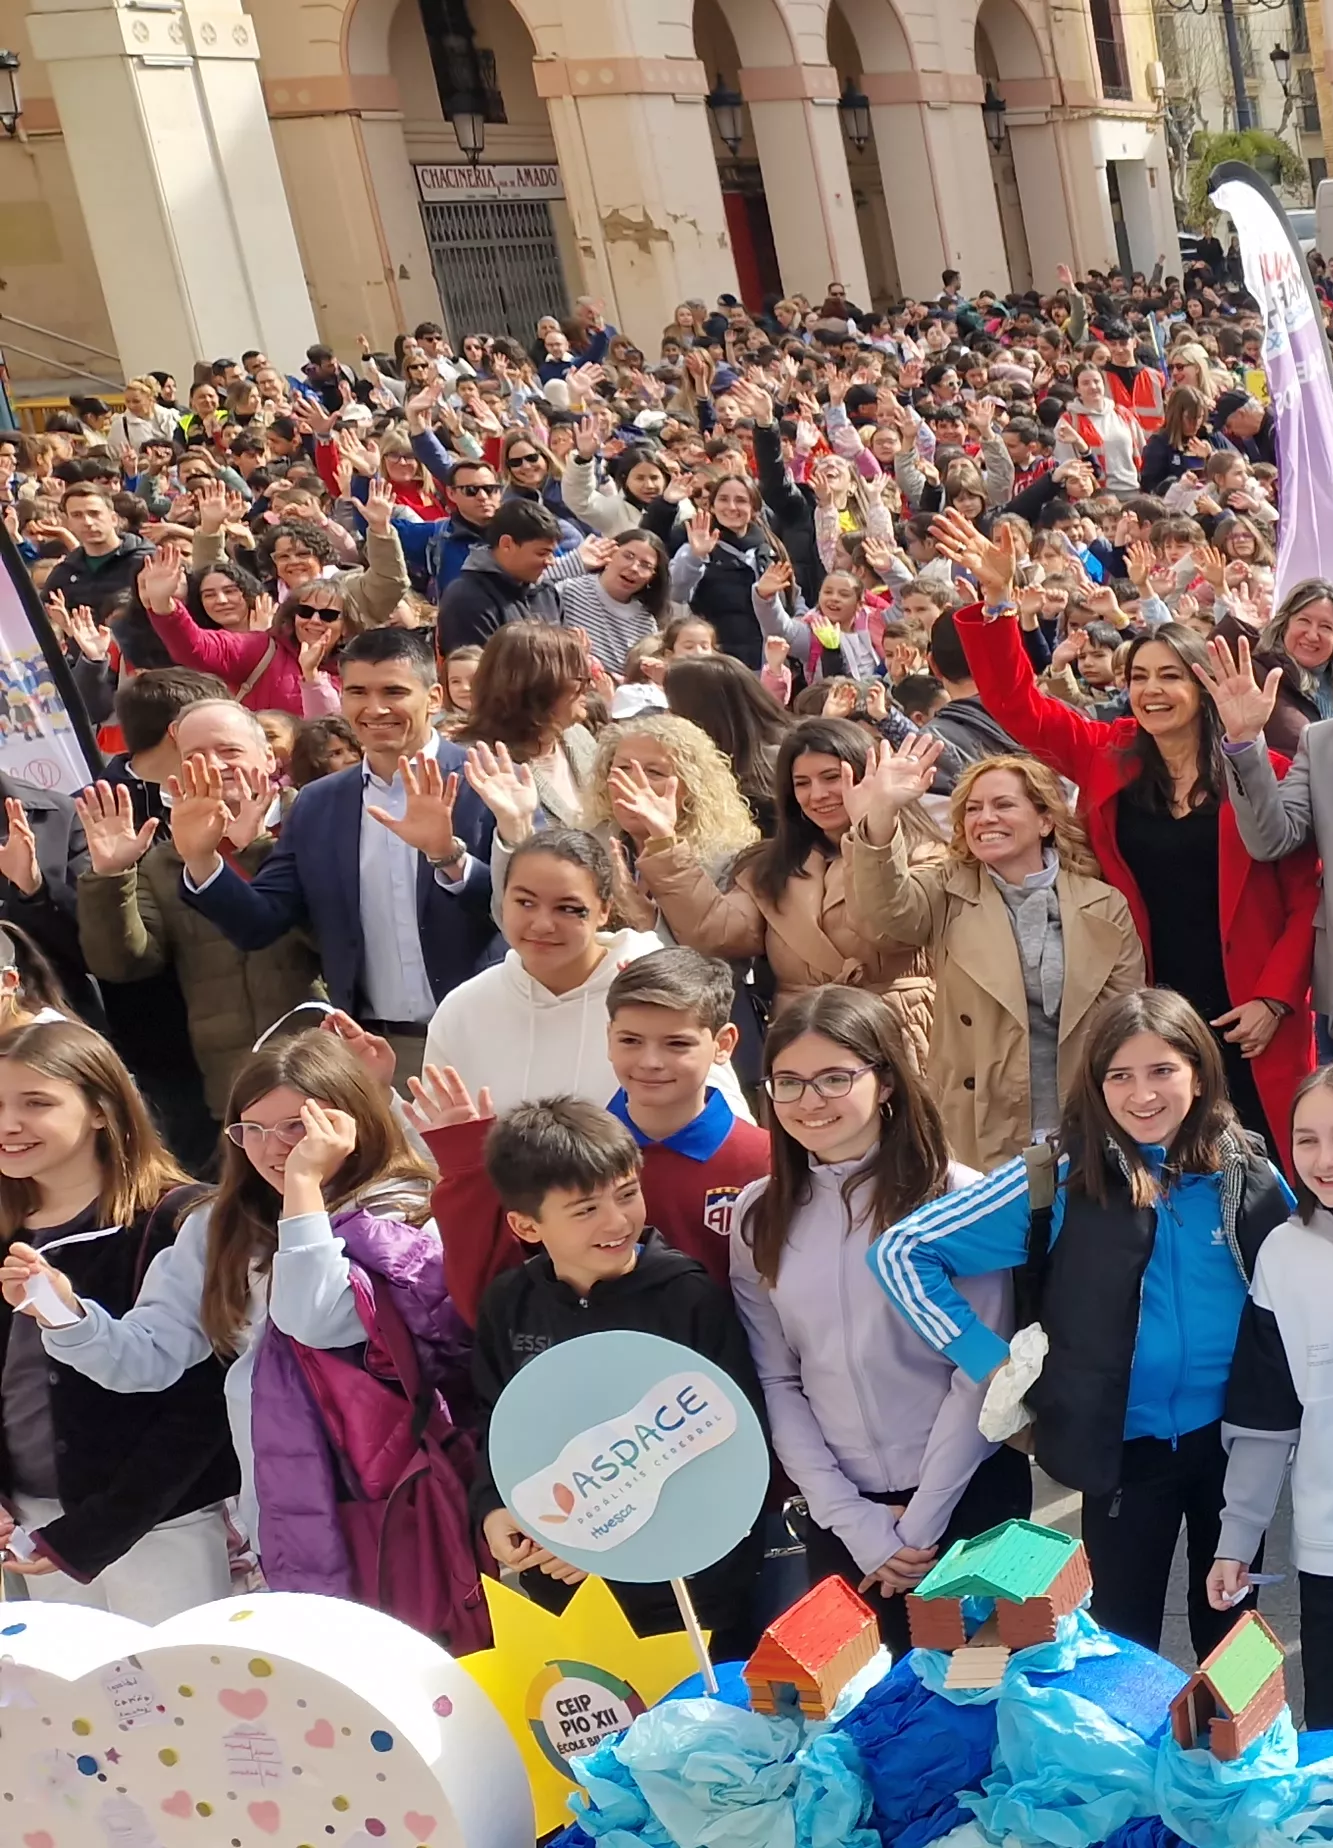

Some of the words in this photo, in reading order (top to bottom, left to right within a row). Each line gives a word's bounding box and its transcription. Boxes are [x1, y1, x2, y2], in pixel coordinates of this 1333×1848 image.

[516, 168, 557, 187] AMADO
[572, 1385, 709, 1499] ASPACE
[653, 1414, 723, 1468] CEREBRAL
[590, 1503, 637, 1540] Huesca
[555, 1694, 592, 1718] CEIP
[559, 1716, 592, 1738] PIO
[591, 1708, 620, 1729] XII
[556, 1741, 588, 1755] ÉCOLE
